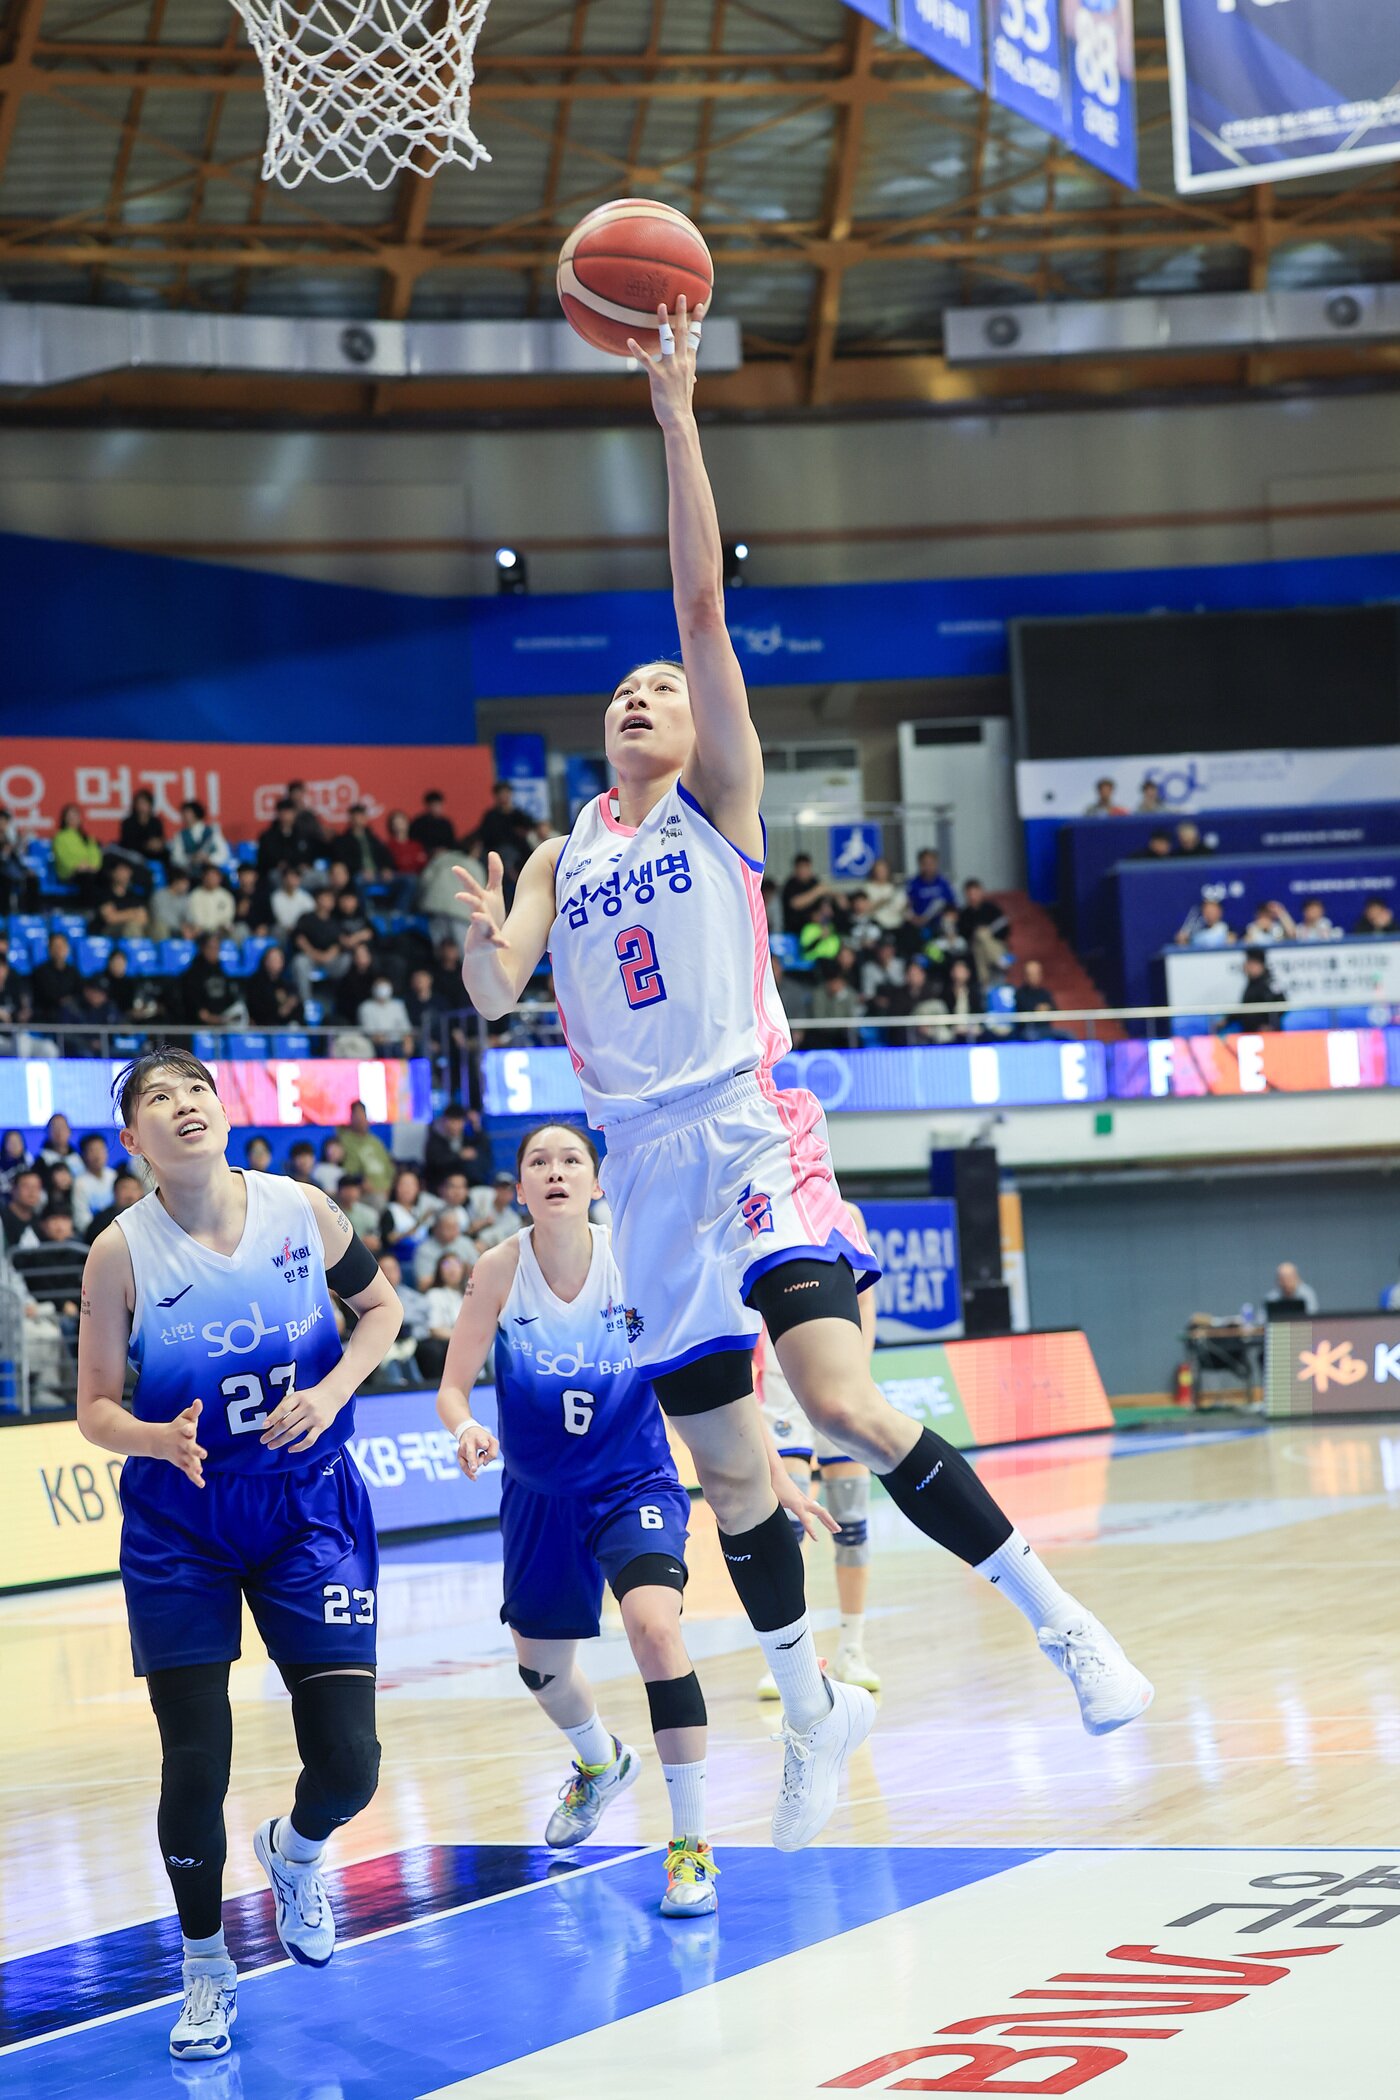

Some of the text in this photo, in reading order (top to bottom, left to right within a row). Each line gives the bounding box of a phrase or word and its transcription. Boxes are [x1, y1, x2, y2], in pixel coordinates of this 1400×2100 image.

[560, 850, 693, 931] 삼성생명
[614, 924, 667, 1011] 2
[869, 1229, 955, 1270] OCARI
[284, 1265, 310, 1283] 인천
[160, 1301, 324, 1358] 신한 SOL Bank
[535, 1341, 595, 1378] SOL
[599, 1357, 634, 1376] Ban
[561, 1388, 596, 1436] 6
[638, 1504, 665, 1531] 6
[322, 1584, 375, 1625] 23
[816, 1943, 1344, 2095] BNK
